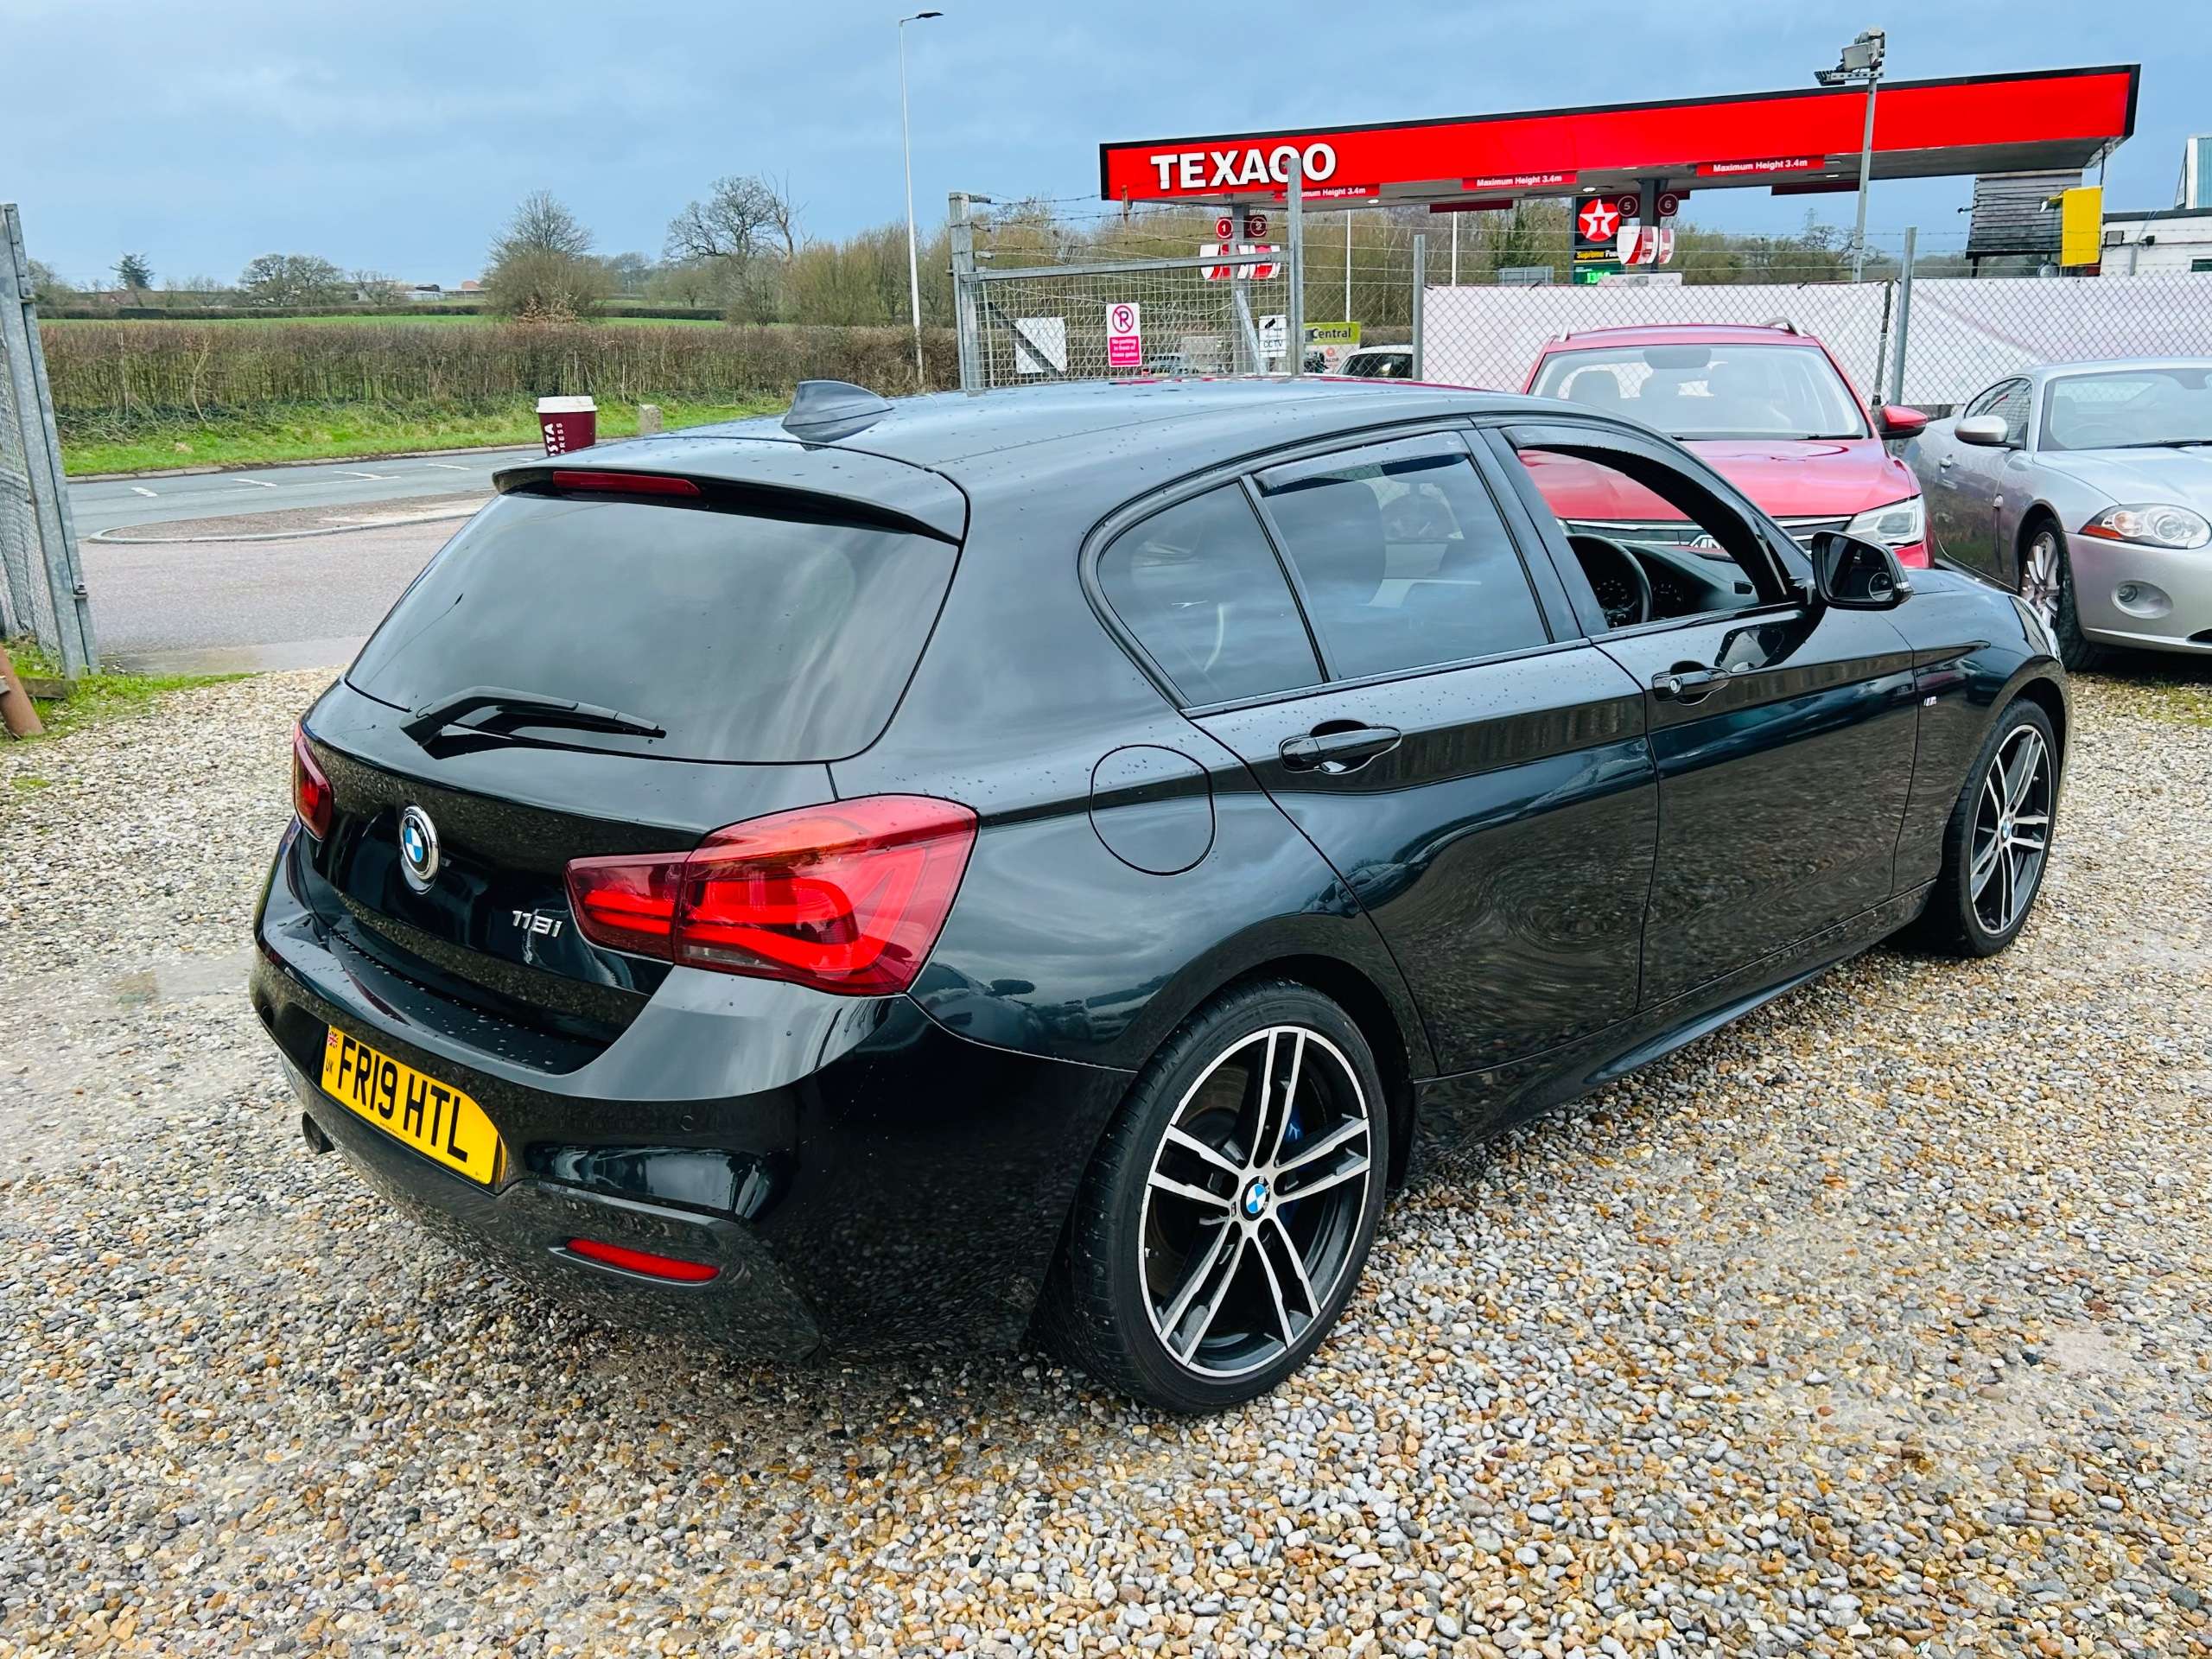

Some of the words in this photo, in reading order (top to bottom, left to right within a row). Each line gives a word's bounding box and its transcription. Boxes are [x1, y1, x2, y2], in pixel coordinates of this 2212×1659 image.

[1150, 143, 1337, 190] TEXACO
[1713, 163, 1753, 173] Maximum
[1755, 160, 1783, 170] Height
[1784, 159, 1808, 168] 3.4m
[1476, 178, 1513, 188] Maximum
[1515, 175, 1541, 185] Height
[1541, 175, 1562, 183] 3.4m
[1322, 188, 1346, 197] Height
[1347, 187, 1366, 195] 3.4m
[1313, 327, 1351, 340] Central
[512, 910, 563, 938] 118i
[336, 1034, 398, 1121] FR19
[402, 1072, 468, 1163] HTL
